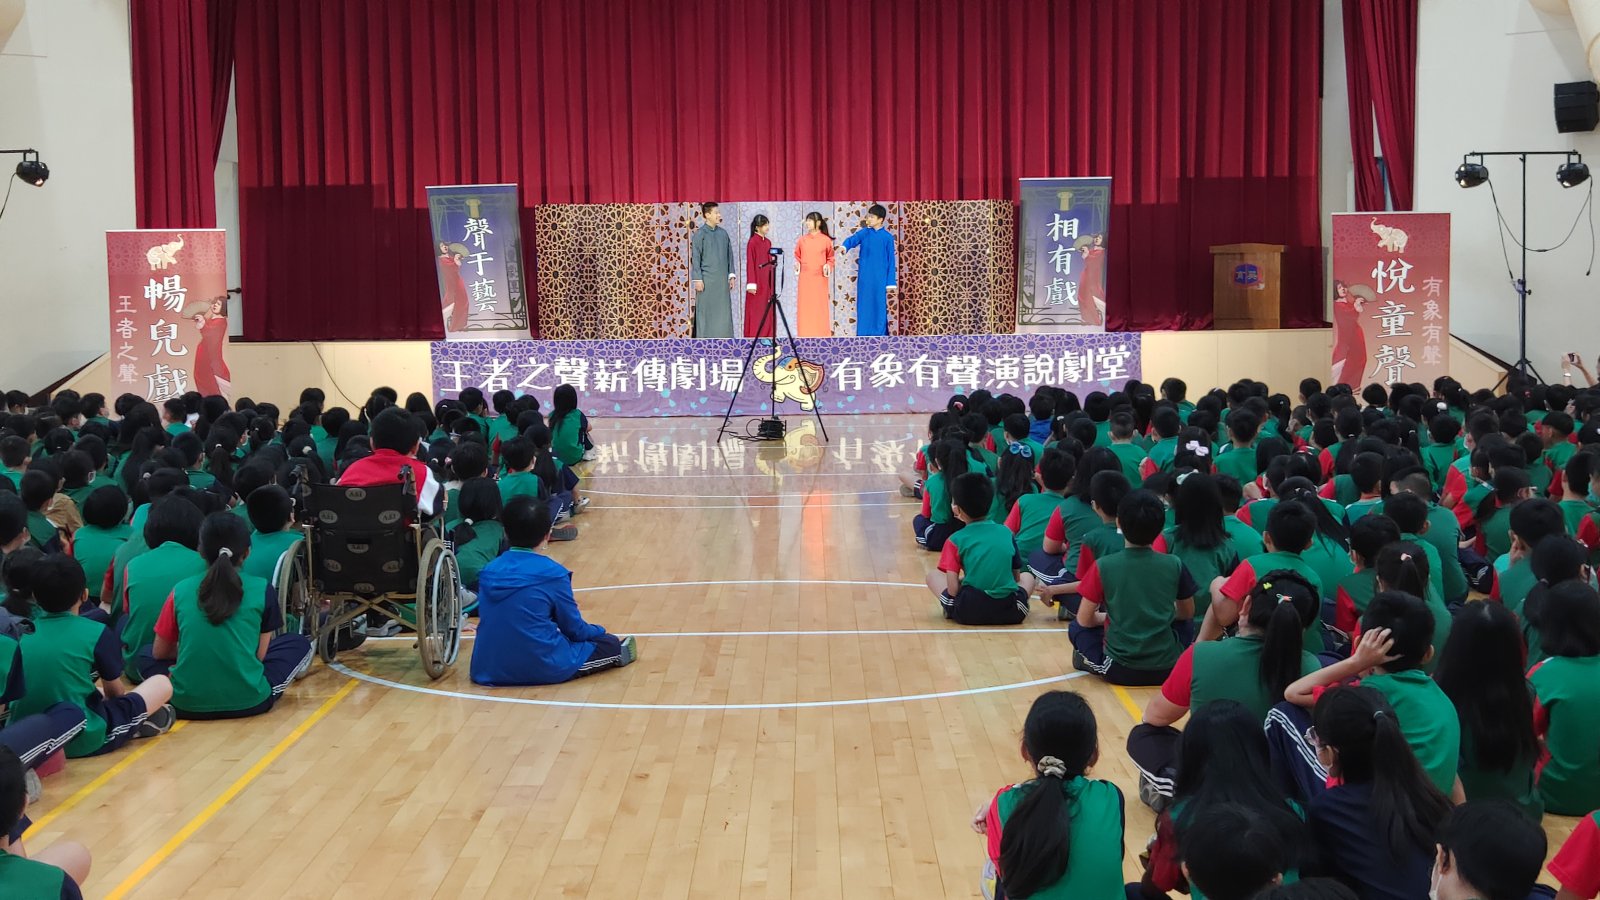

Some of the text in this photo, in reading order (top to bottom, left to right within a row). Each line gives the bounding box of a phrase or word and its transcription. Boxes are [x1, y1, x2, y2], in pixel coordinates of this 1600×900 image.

[1044, 213, 1079, 306] 相有戲
[115, 295, 139, 385] 王者之聲
[144, 274, 188, 403] 暢兒戲
[1369, 257, 1416, 386] 悅童聲
[1422, 276, 1444, 366] 有象有聲
[439, 356, 745, 393] 王者之聲薪傳劇場
[830, 345, 1132, 391] 有象有聲演說劇堂
